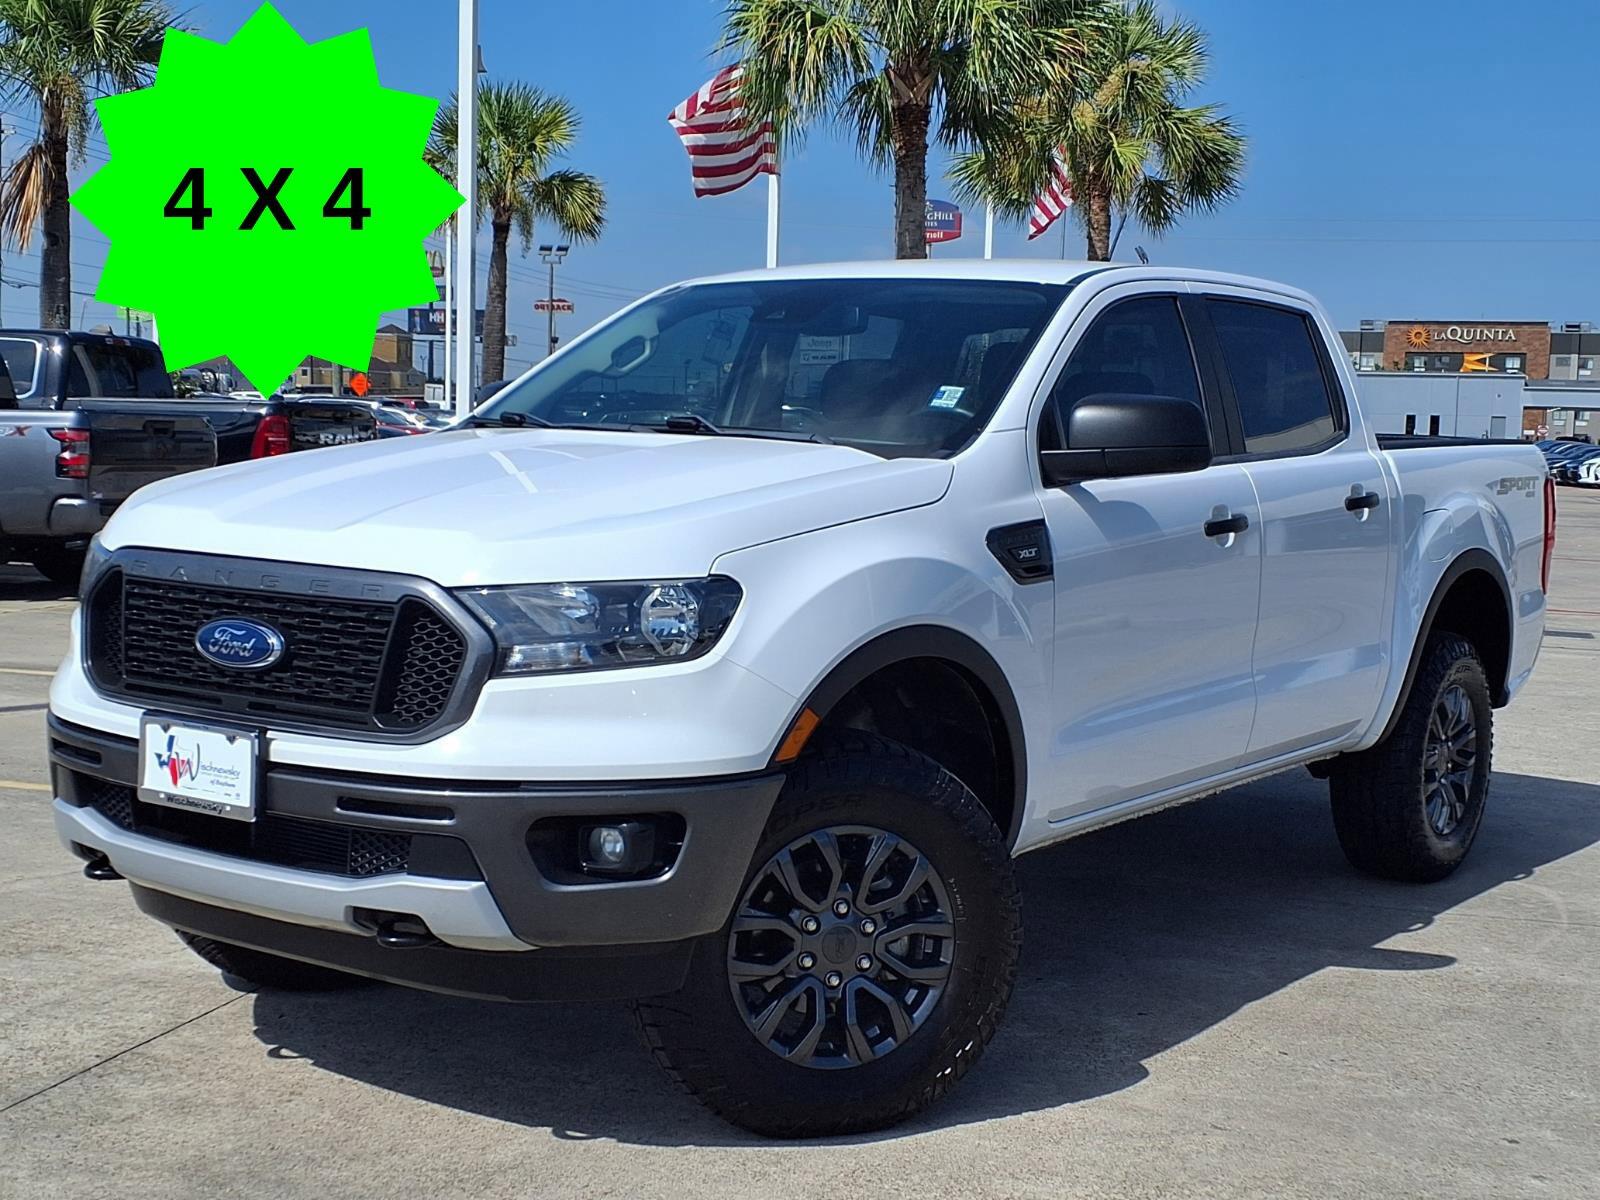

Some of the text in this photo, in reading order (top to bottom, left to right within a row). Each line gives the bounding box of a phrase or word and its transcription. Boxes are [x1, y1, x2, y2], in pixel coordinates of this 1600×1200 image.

[925, 211, 954, 220] GHILL
[1496, 475, 1540, 496] SPORT
[1018, 547, 1039, 560] XLT
[129, 558, 385, 599] RANGER
[207, 625, 255, 659] Ford
